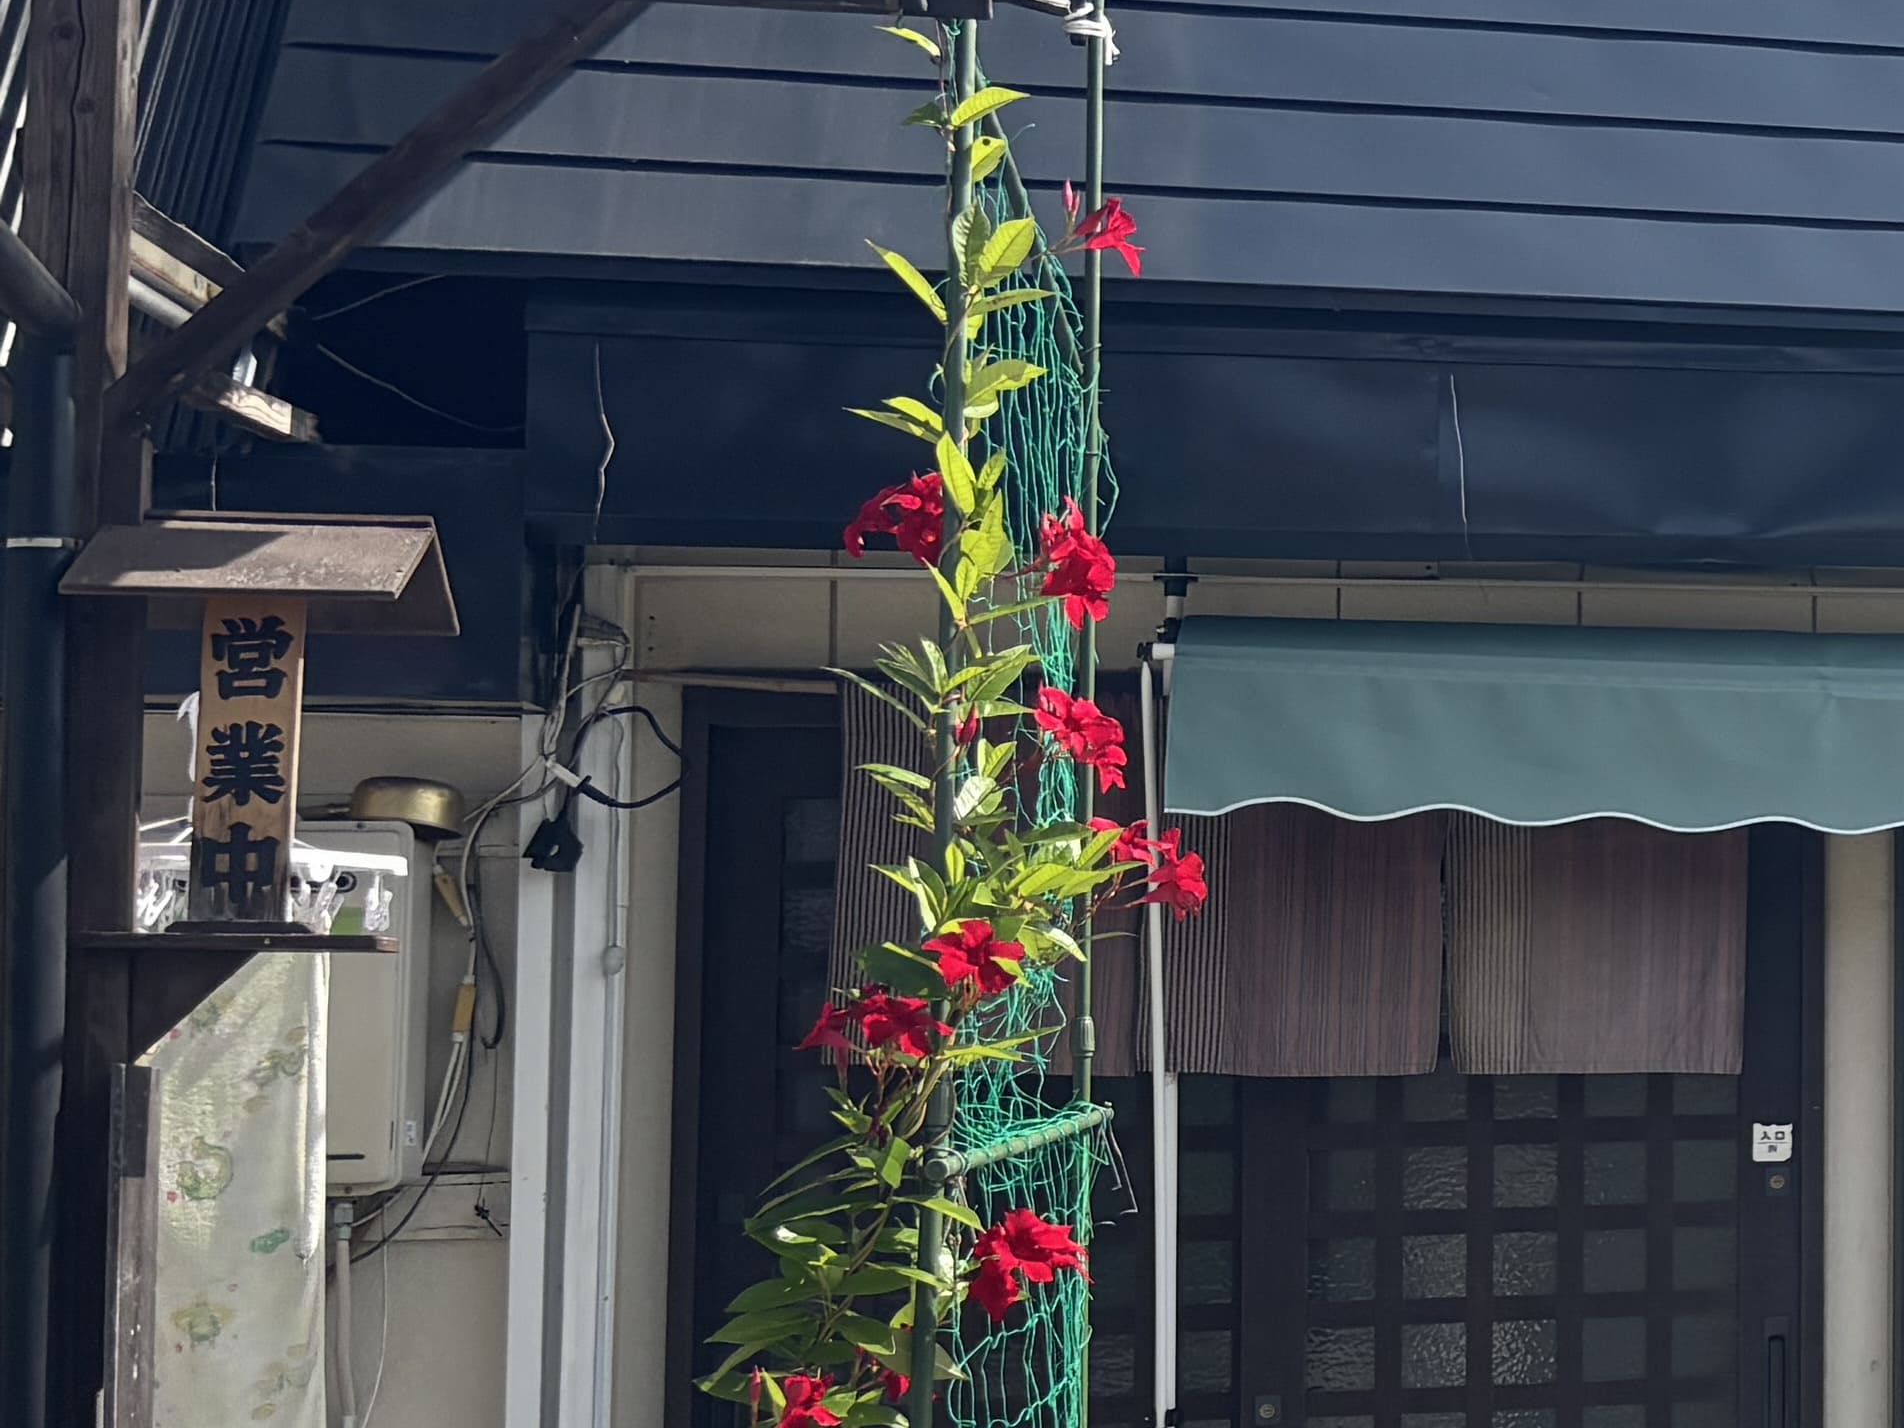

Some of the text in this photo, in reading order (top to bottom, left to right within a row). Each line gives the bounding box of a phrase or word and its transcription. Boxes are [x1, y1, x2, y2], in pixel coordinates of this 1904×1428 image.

[202, 615, 294, 905] 営業中
[1760, 1130, 1785, 1140] 入口
